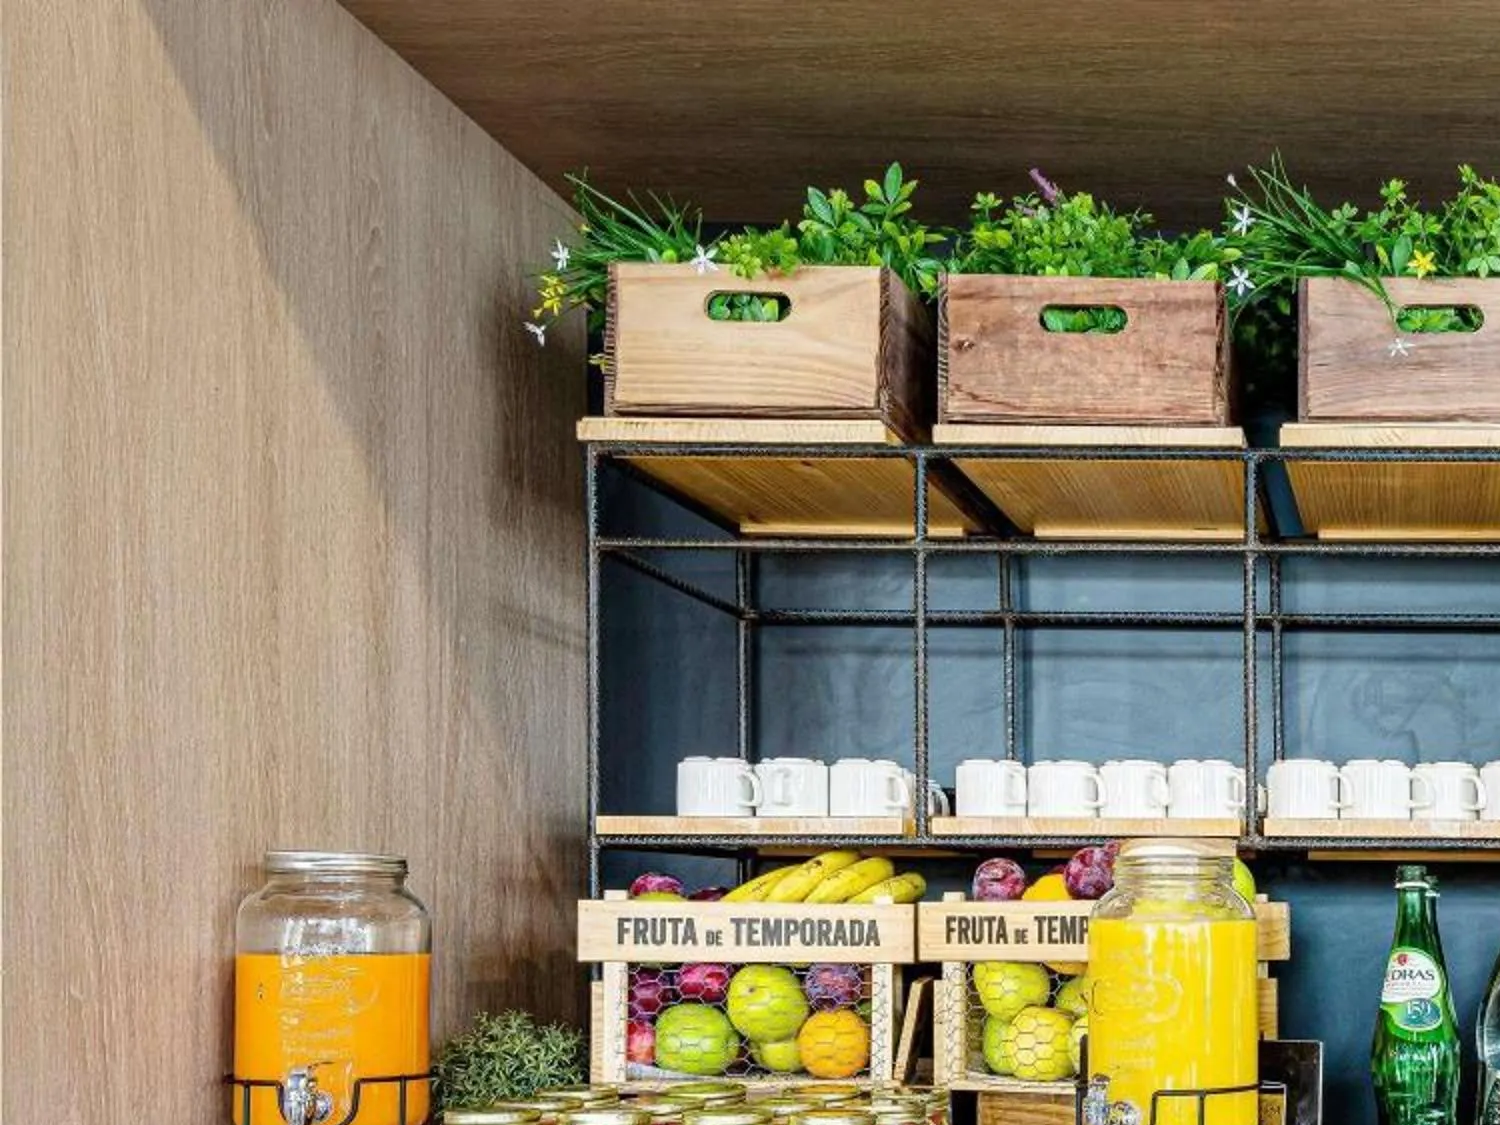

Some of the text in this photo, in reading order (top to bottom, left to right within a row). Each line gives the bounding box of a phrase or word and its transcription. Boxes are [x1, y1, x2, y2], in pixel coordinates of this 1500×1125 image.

[617, 917, 881, 947] FRUTA DE TEMPORADA
[945, 915, 1009, 945] FRUTA
[1014, 928, 1029, 945] DE
[1387, 968, 1435, 981] DRAS
